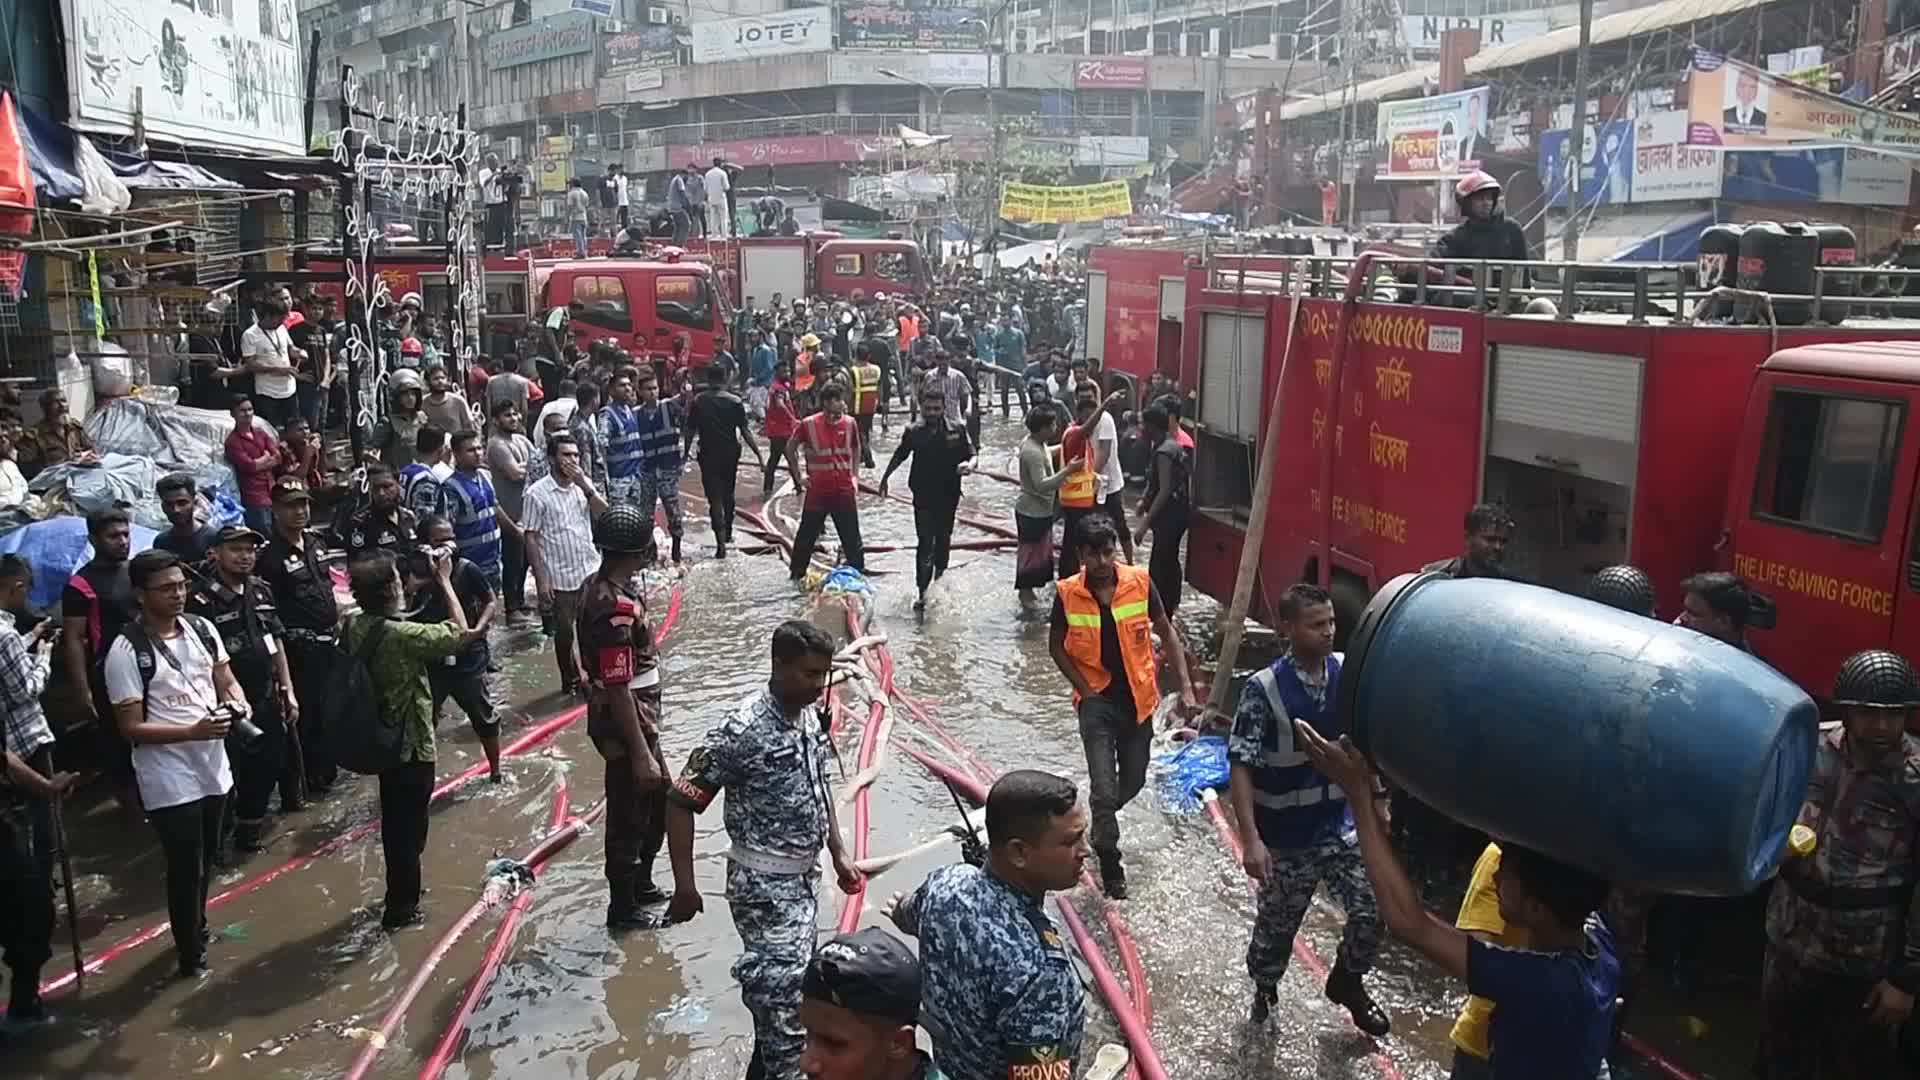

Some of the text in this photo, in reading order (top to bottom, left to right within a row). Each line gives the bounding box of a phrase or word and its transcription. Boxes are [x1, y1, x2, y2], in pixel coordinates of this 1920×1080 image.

[735, 20, 815, 44] JOTEY
[1734, 553, 1893, 616] THE LIFE SAVING FORCE
